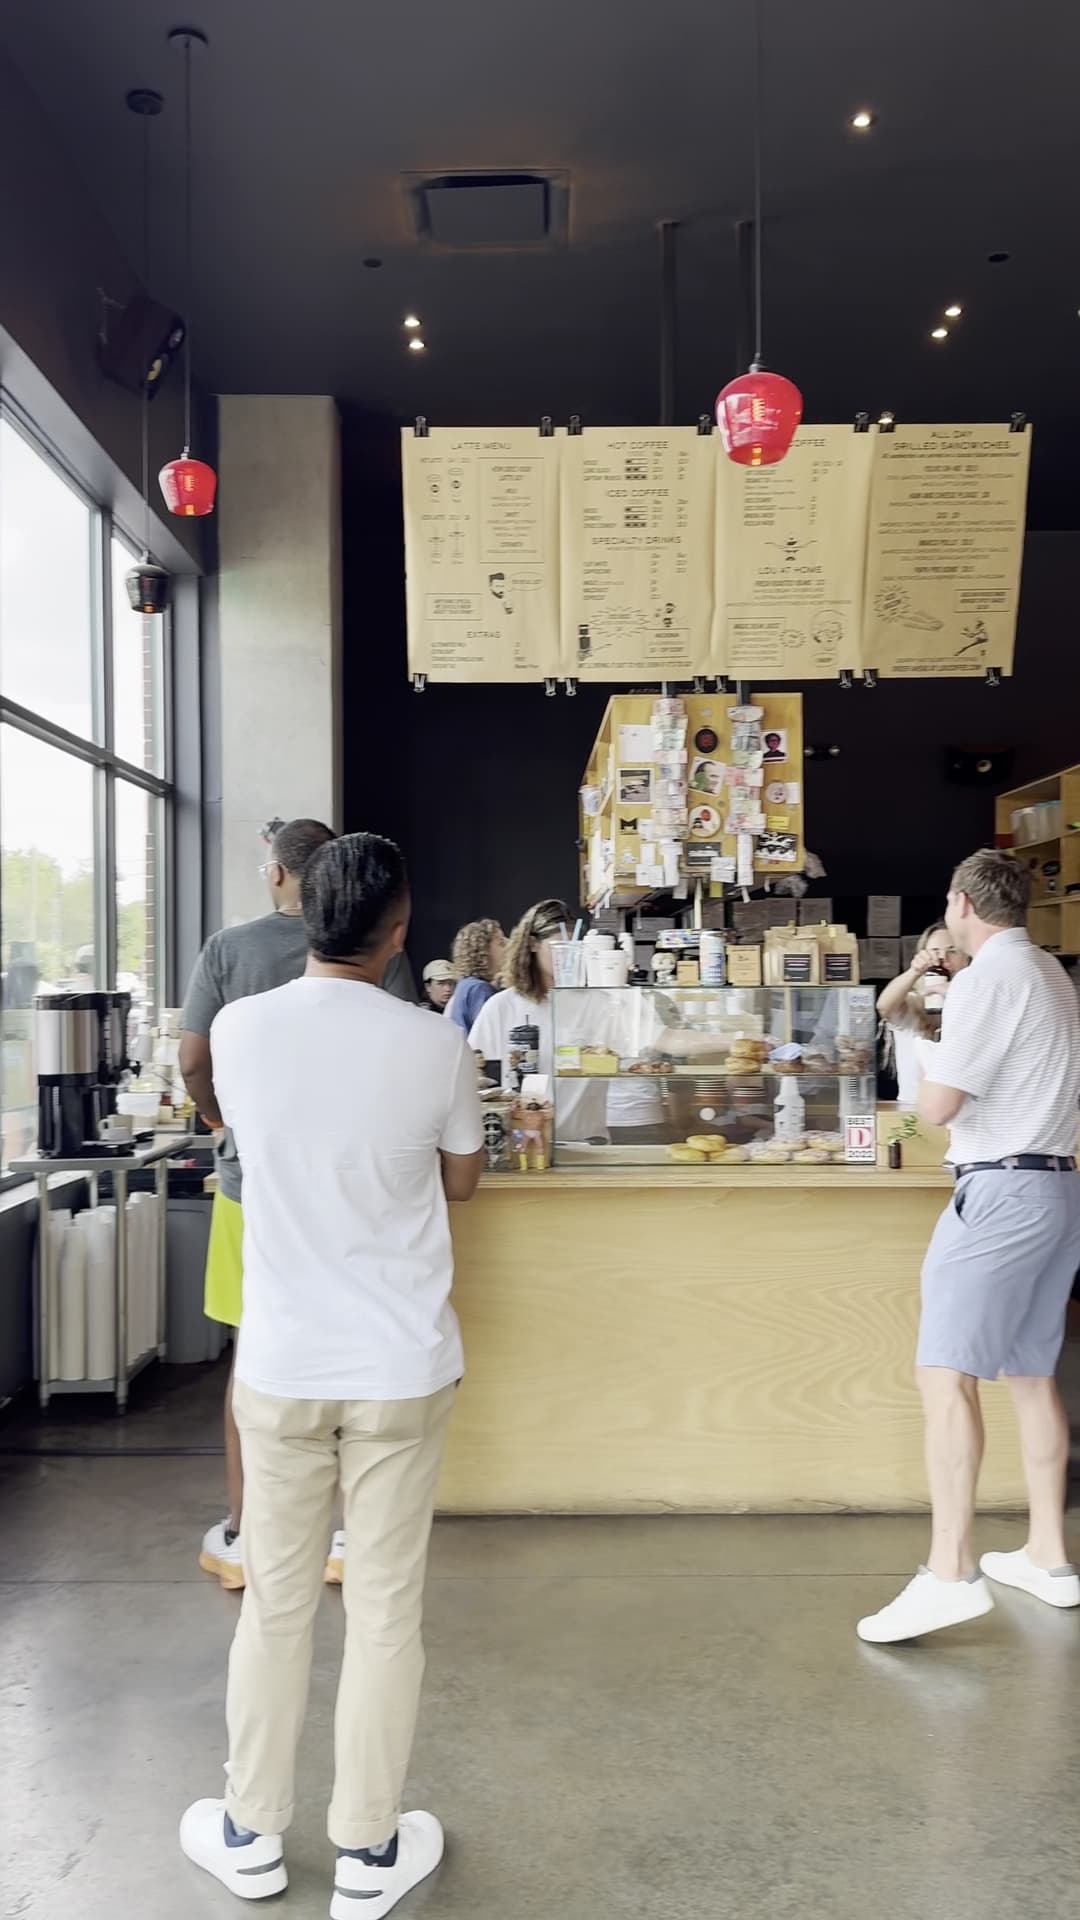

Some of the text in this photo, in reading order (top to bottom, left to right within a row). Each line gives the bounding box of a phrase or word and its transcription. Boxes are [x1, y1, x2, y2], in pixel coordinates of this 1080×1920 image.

[930, 430, 973, 439] ALL DAY
[451, 442, 512, 450] LATTE MENU
[608, 441, 669, 449] HOT COFFEE
[893, 441, 1011, 450] GRILLED SANDWICHES
[606, 488, 670, 498] ICED COFFEE
[591, 536, 681, 545] SPECIALTY DRINKS
[794, 565, 823, 574] HOME
[848, 1127, 873, 1149] D
